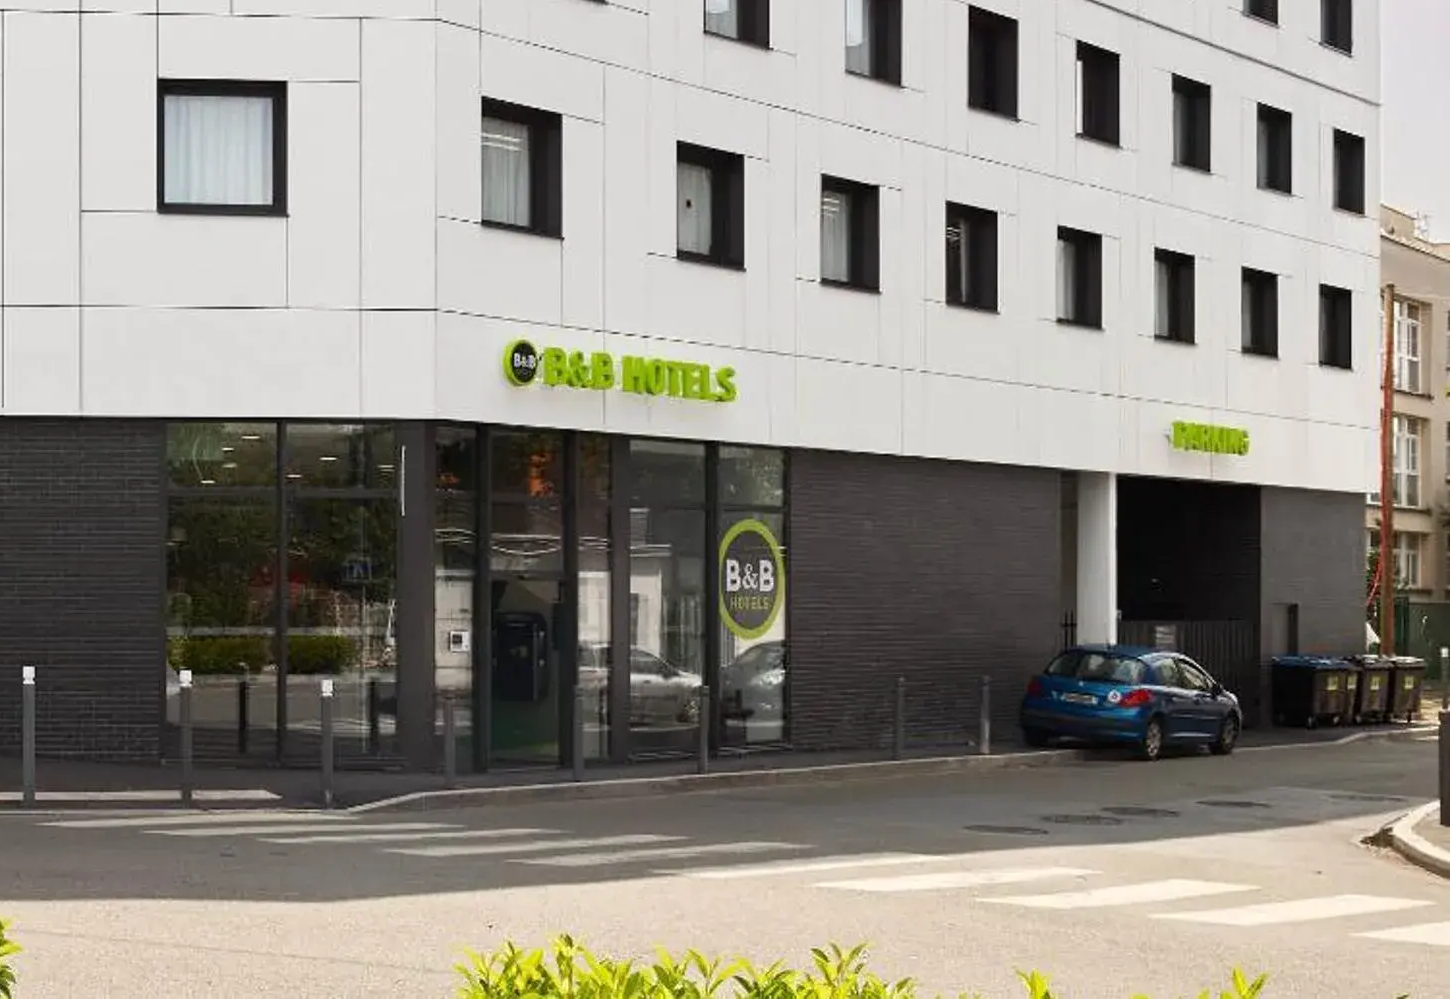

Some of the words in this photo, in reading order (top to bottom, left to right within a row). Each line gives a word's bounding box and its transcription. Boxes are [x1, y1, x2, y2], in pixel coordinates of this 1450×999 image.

[543, 346, 615, 390] B&B
[621, 355, 737, 402] HOTELS
[1172, 421, 1249, 456] PARKING
[725, 558, 775, 592] B&B
[729, 595, 770, 611] HOTELS
